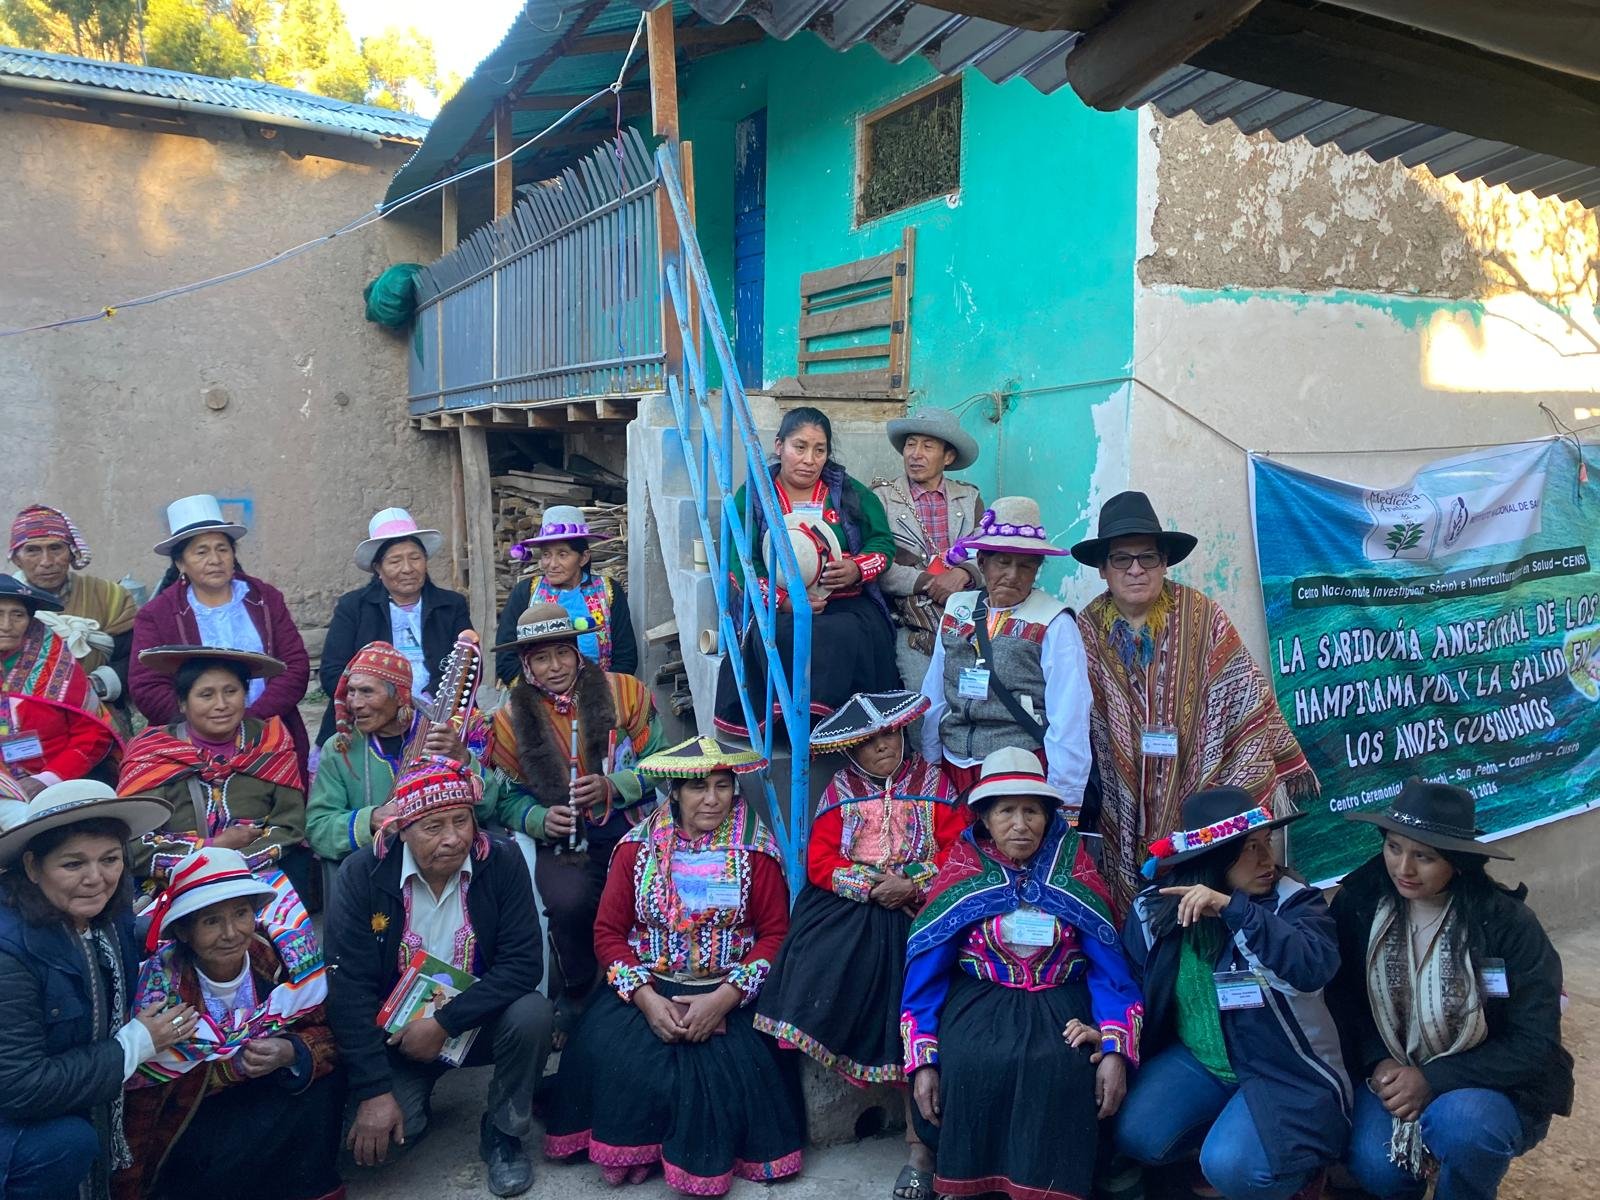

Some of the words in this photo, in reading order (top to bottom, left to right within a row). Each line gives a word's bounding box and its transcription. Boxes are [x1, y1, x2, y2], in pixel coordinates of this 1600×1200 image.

[1518, 501, 1529, 511] DE
[1322, 584, 1363, 598] Naciona
[1461, 582, 1466, 590] e
[1278, 636, 1306, 674] LA
[1431, 607, 1529, 659] ANCESTRAL
[1536, 601, 1556, 636] DE
[1565, 593, 1599, 629] LOS
[1458, 669, 1470, 700] Y
[1476, 664, 1502, 697] LA
[1510, 647, 1566, 690] SALUD
[1571, 639, 1592, 672] EN
[1345, 730, 1384, 768] LOS
[1394, 717, 1449, 761] ANDES
[1454, 693, 1556, 745] CUSQUEÑOS
[1329, 795, 1360, 812] Centro
[1361, 780, 1403, 804] Ceremonial
[1456, 767, 1472, 780] San
[1474, 762, 1499, 777] Pedro
[1508, 751, 1542, 768] Canchis
[1556, 742, 1580, 757] Cusco
[1477, 781, 1498, 798] 2026
[426, 789, 462, 805] CUSCO
